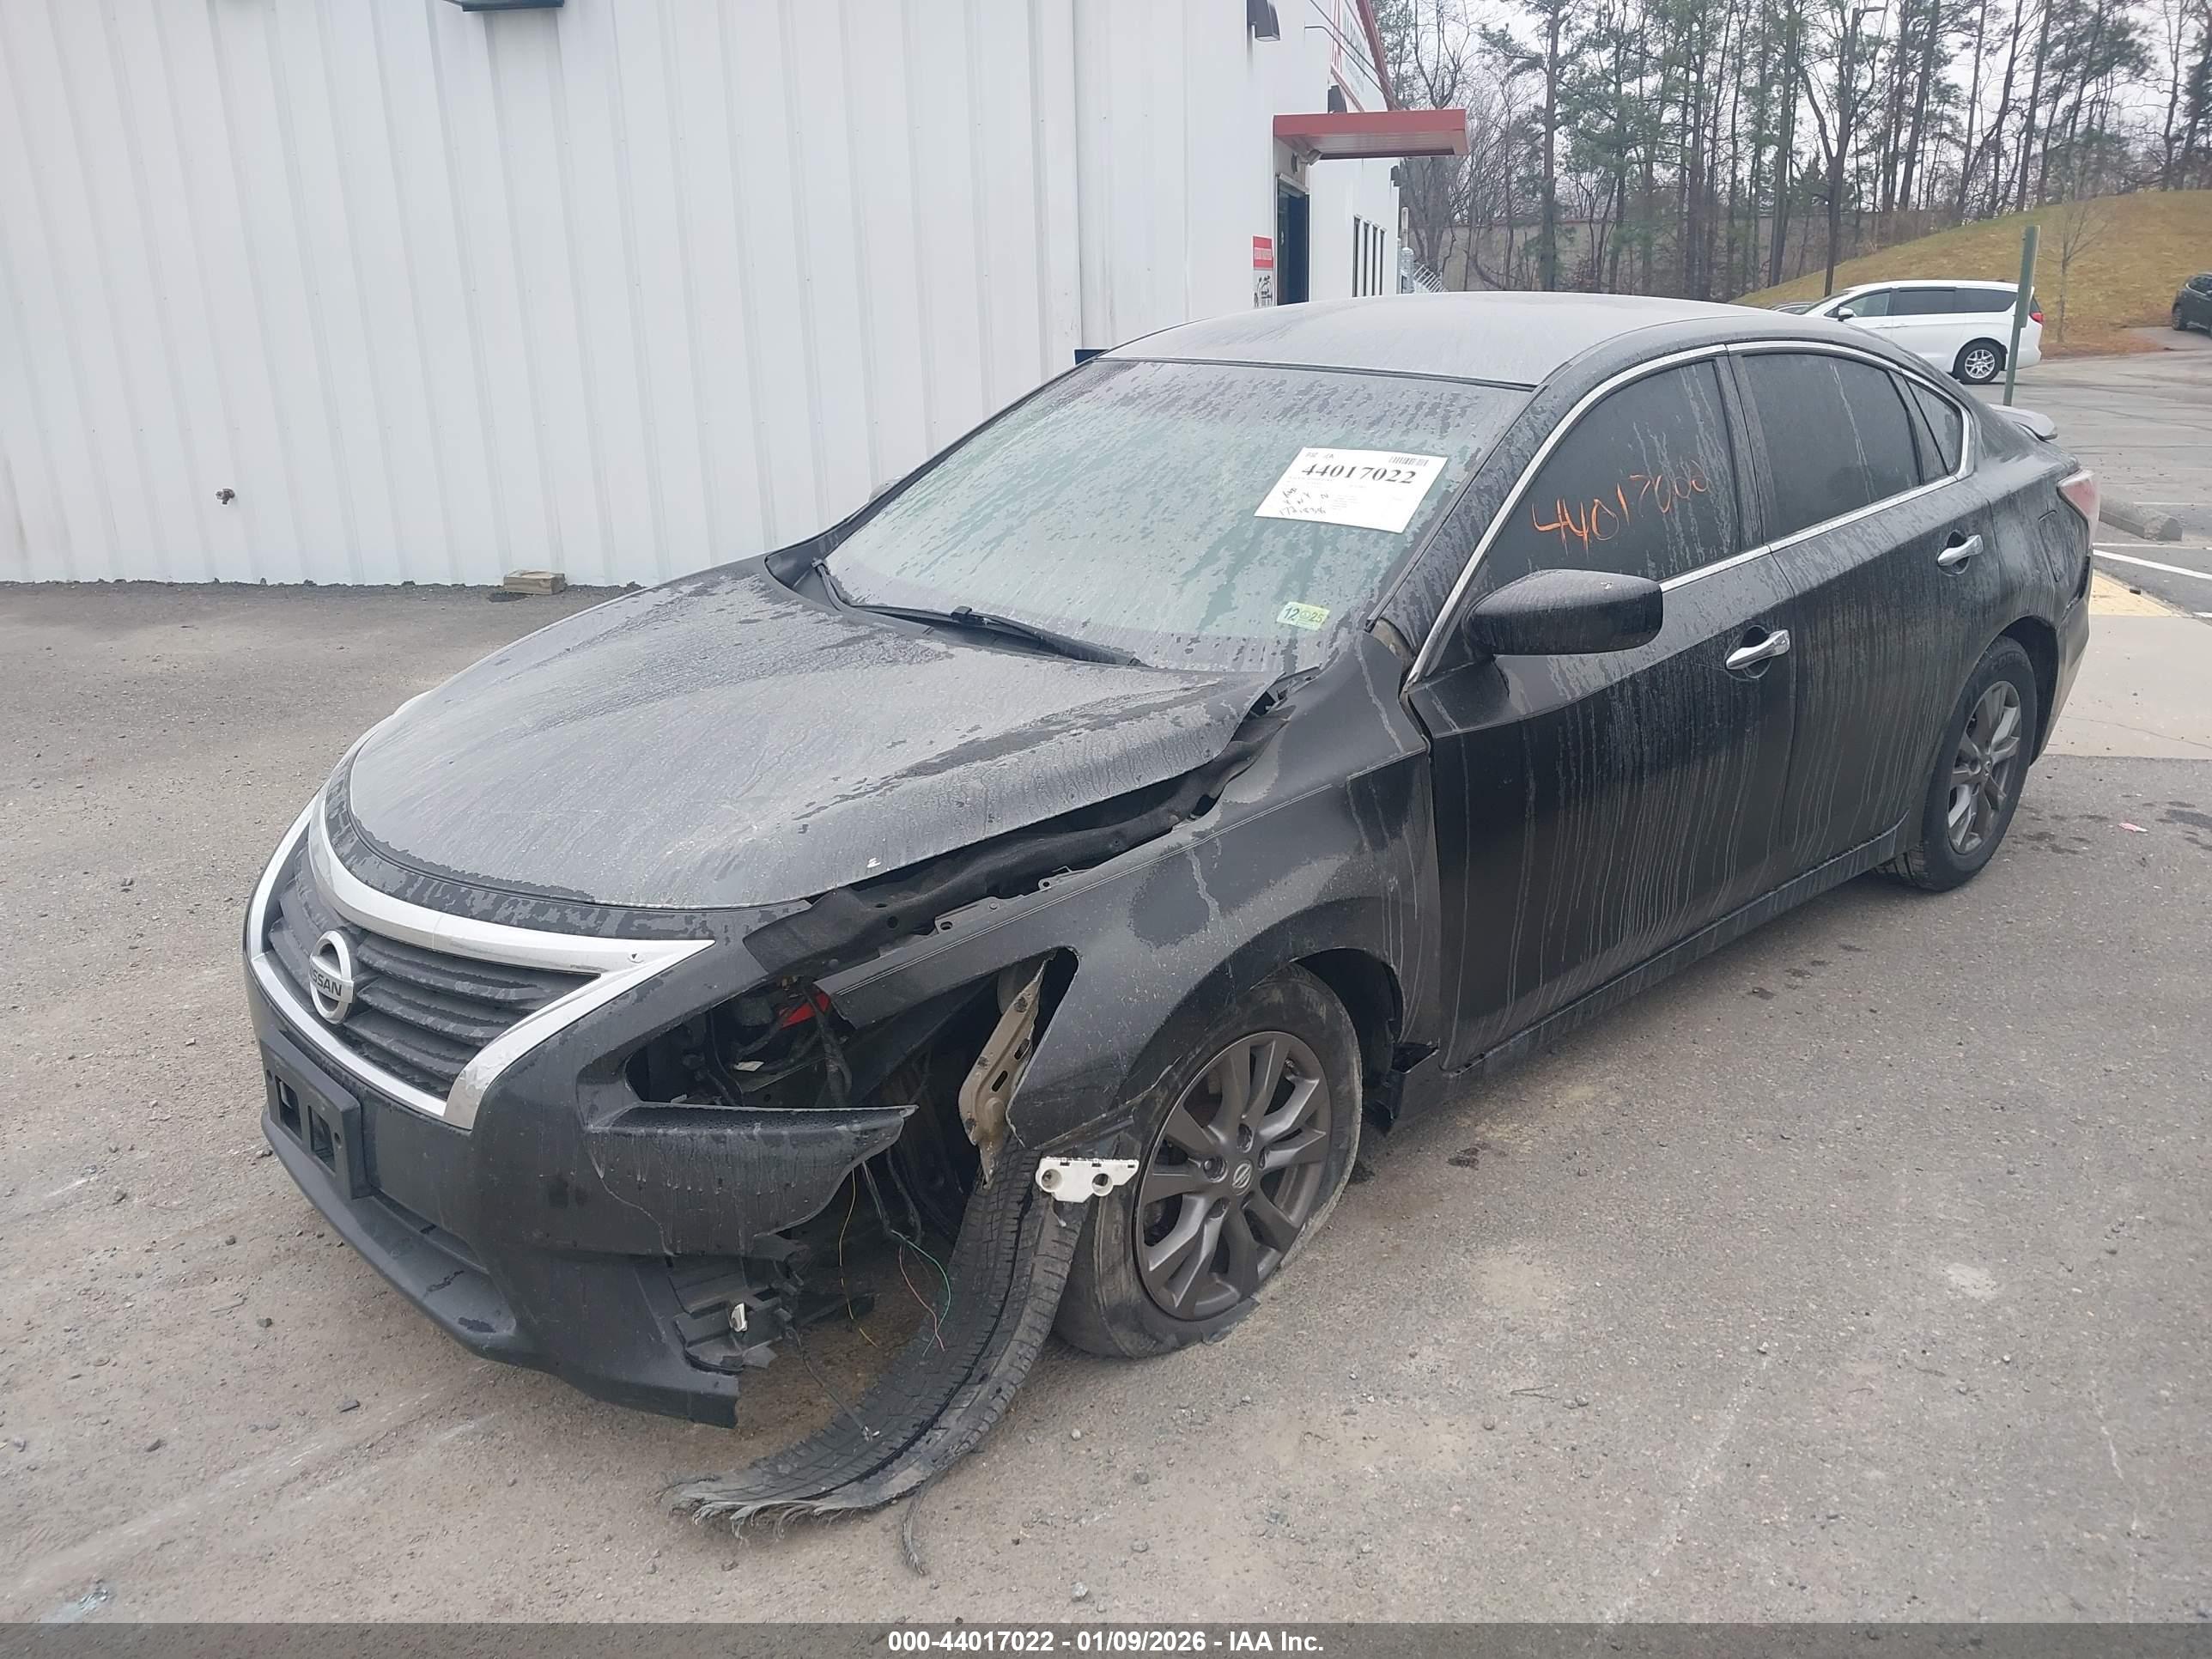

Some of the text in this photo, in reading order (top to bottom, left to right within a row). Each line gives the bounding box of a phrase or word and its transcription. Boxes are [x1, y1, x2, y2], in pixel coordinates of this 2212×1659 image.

[1301, 463, 1417, 484] 44017022
[1284, 606, 1324, 623] 12 25
